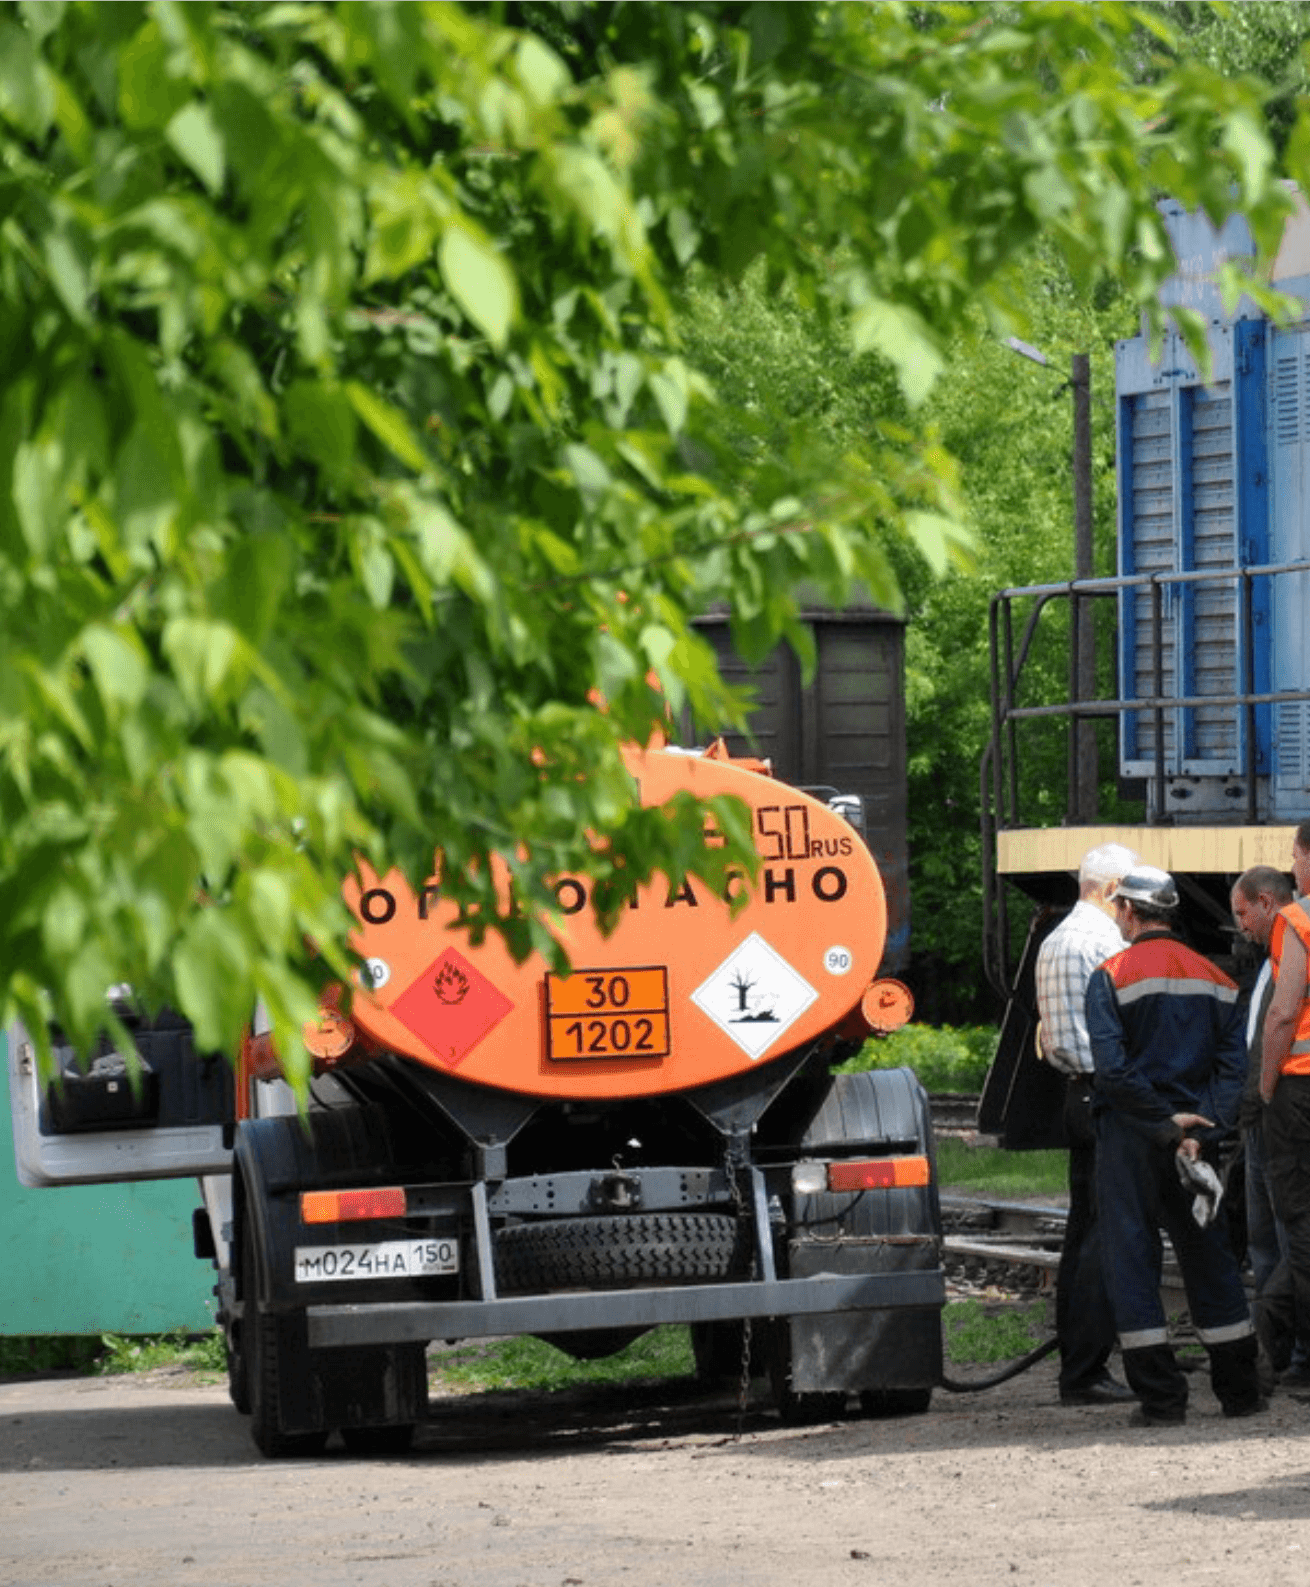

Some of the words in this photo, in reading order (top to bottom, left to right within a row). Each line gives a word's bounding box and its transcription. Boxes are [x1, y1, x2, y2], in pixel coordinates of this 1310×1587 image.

[828, 951, 849, 969] 90
[584, 975, 631, 1009] 30
[565, 1018, 655, 1053] 1202
